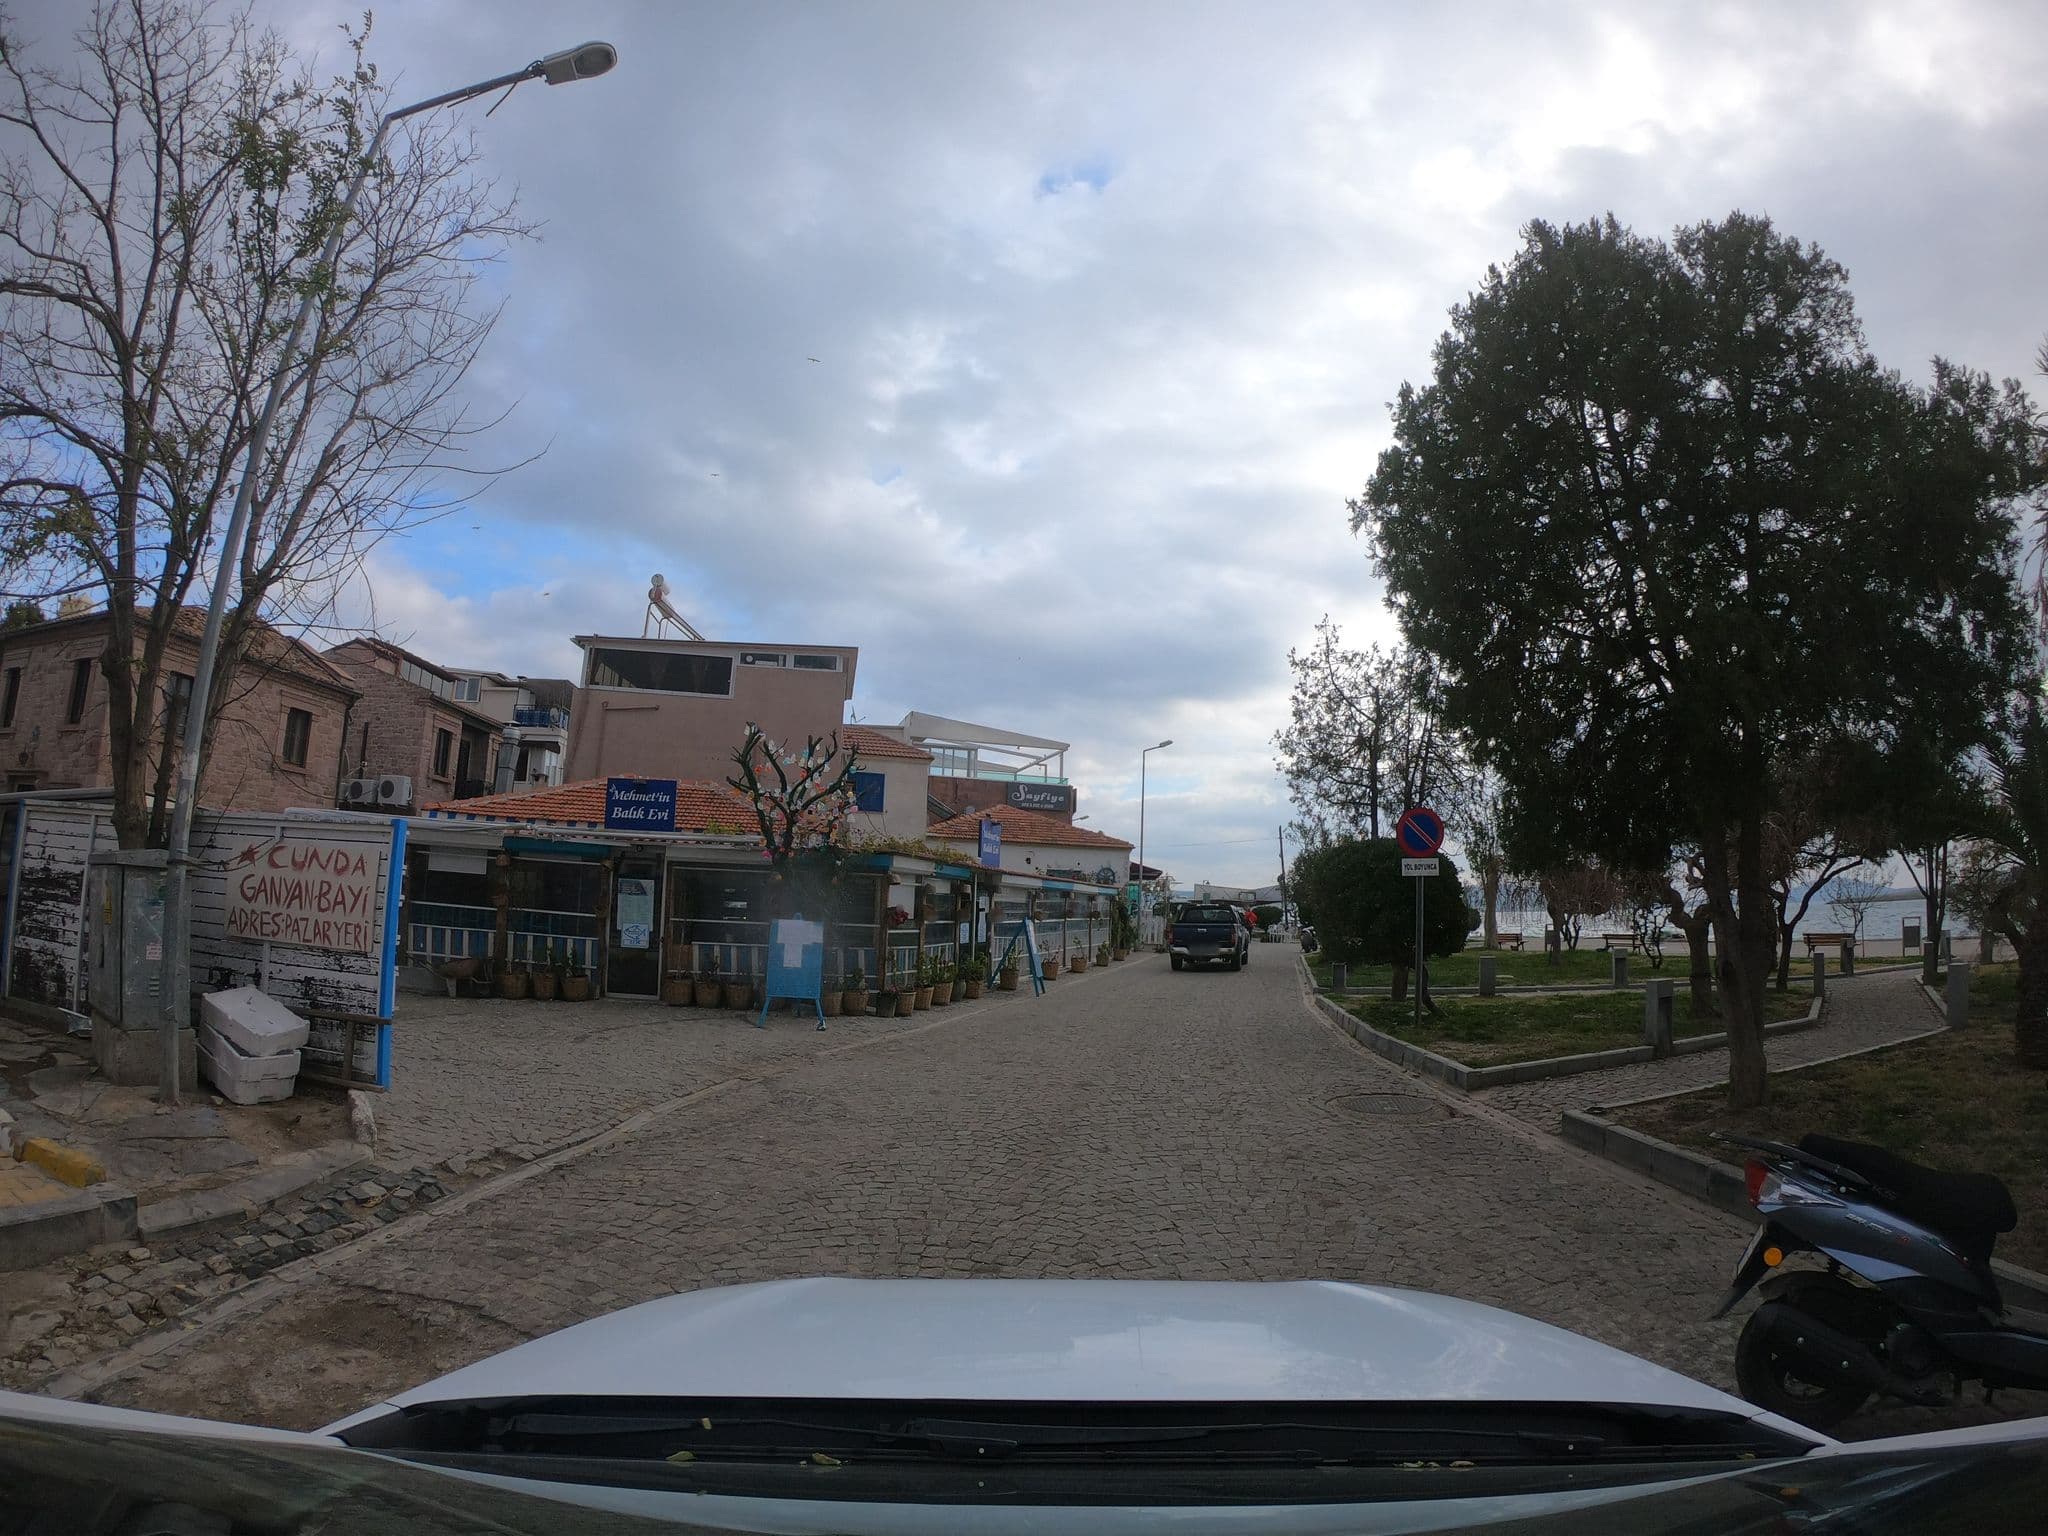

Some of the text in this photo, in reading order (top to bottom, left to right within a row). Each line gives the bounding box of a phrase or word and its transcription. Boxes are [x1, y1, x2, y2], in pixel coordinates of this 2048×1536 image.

[611, 789, 671, 803] Mehmet'in
[611, 806, 669, 821] Balık Evi
[267, 845, 367, 877] CUNDA
